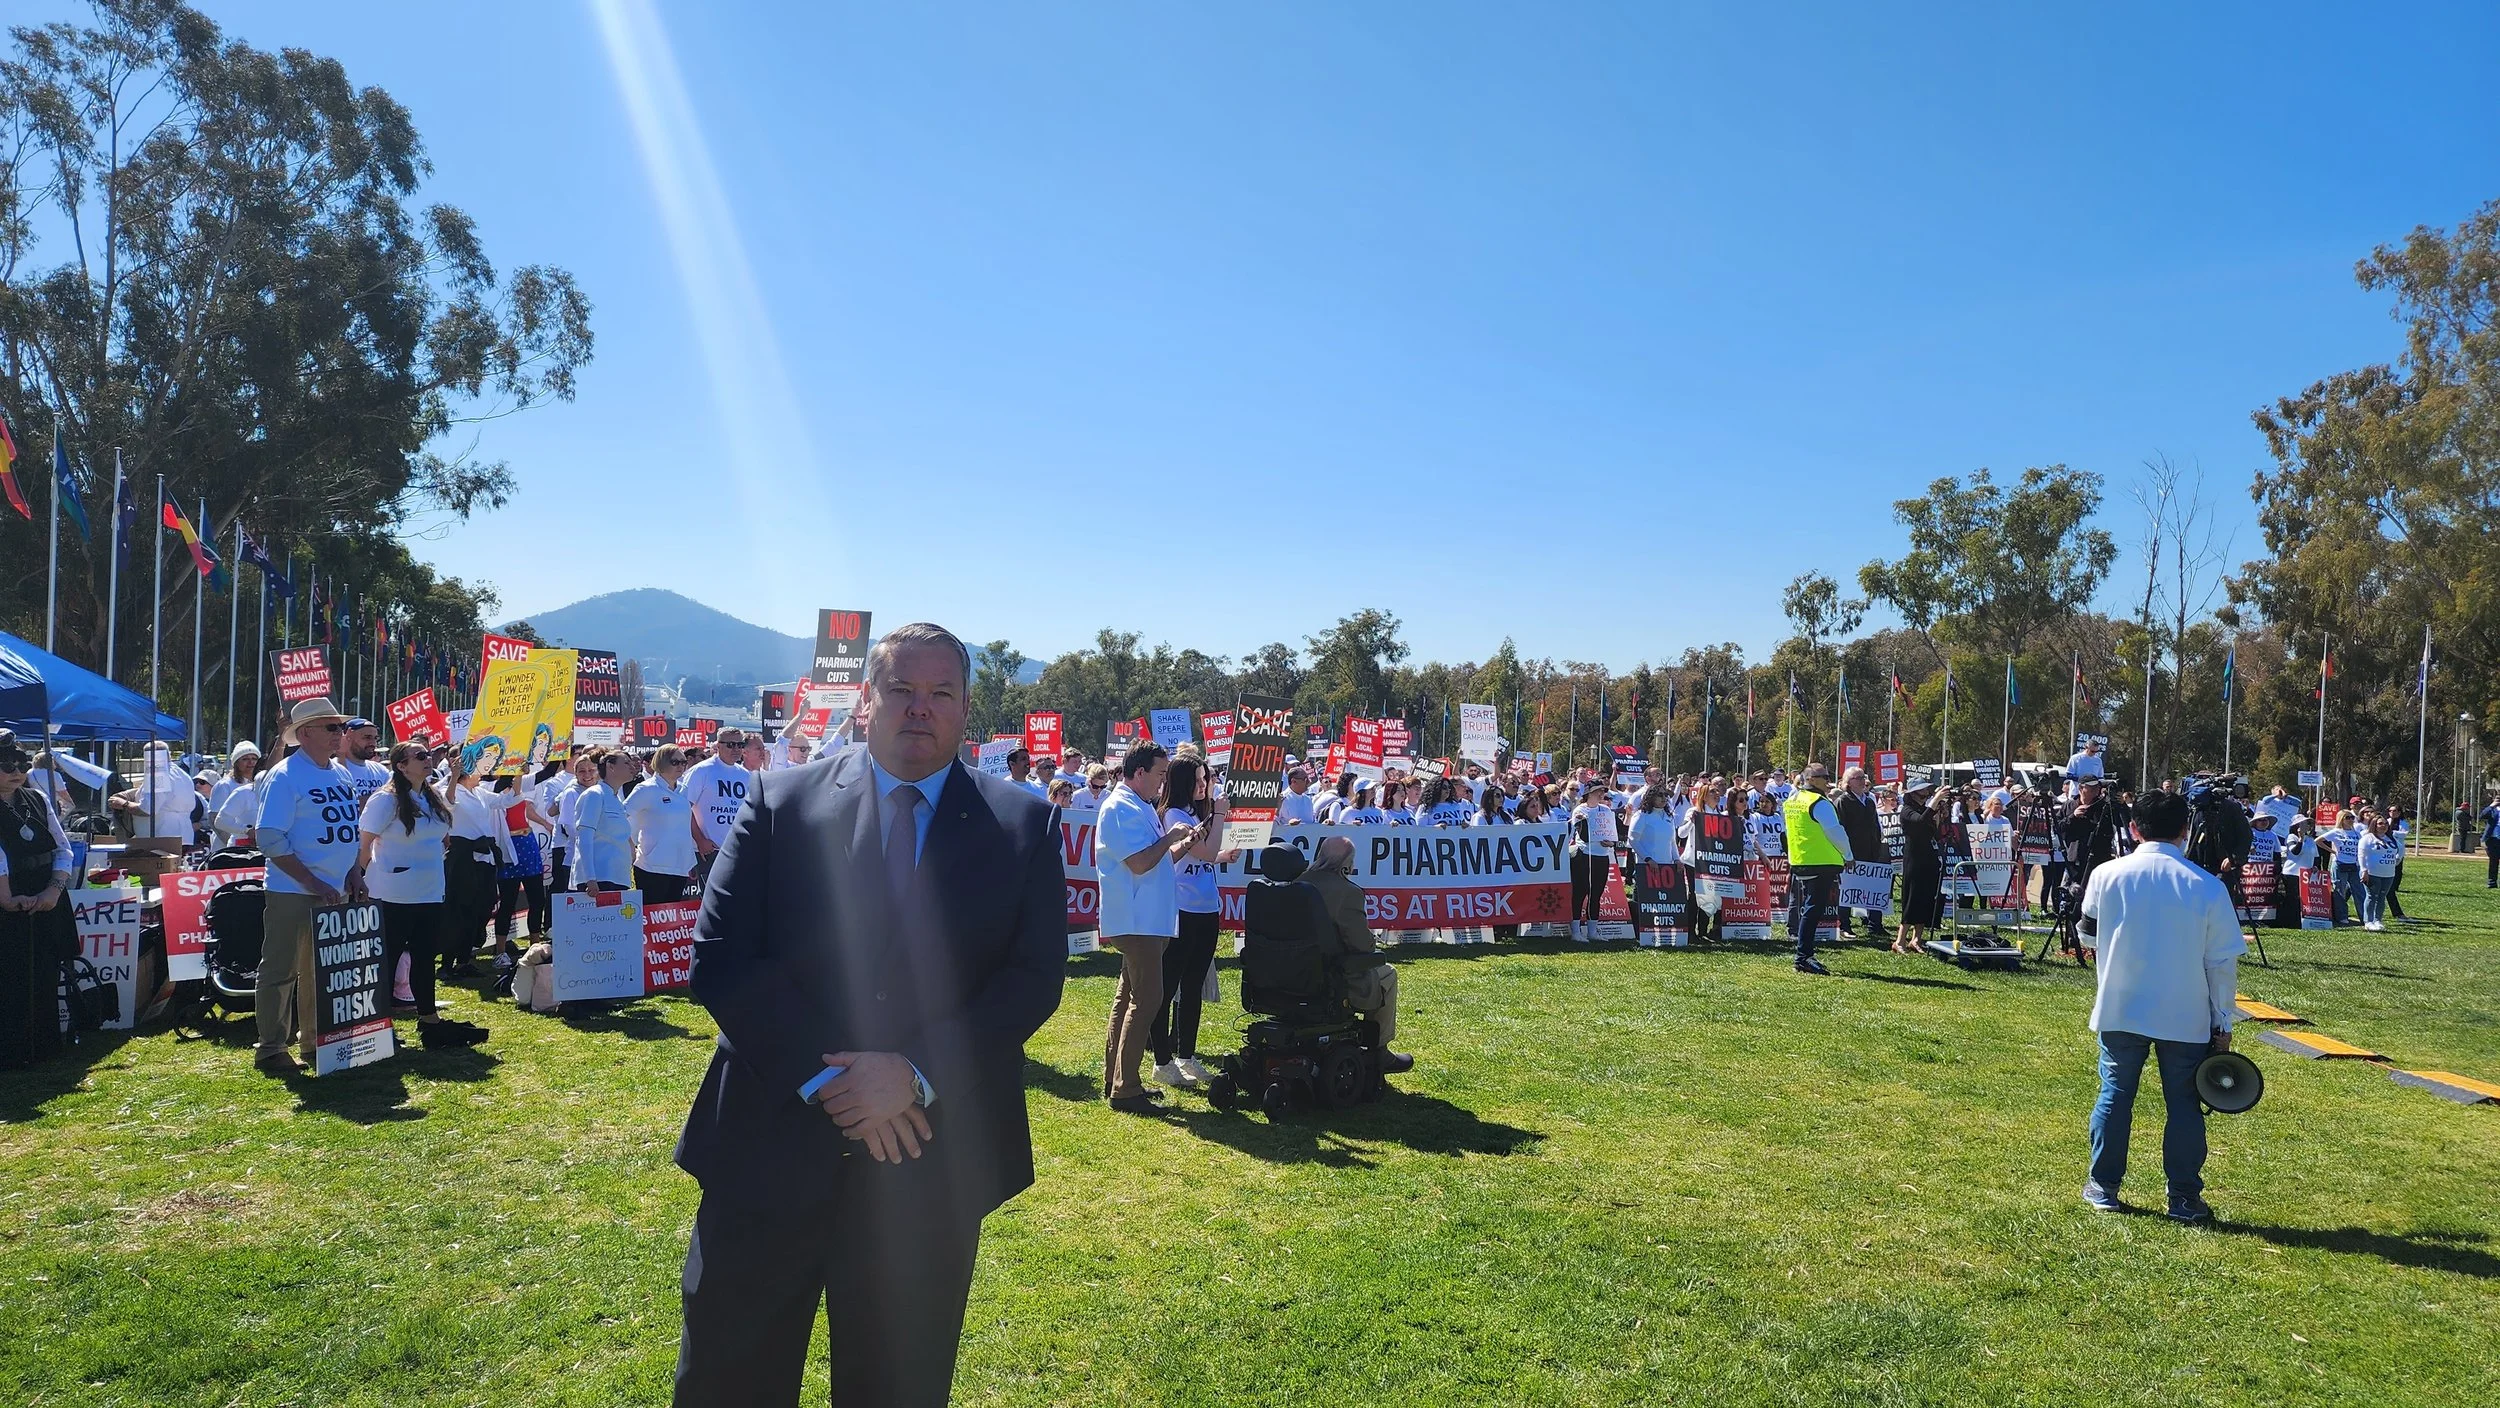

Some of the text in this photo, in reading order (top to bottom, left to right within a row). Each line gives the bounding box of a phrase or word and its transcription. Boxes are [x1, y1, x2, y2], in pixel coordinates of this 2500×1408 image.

[829, 612, 860, 640] NO
[488, 641, 528, 661] SAVE
[838, 643, 847, 654] to
[280, 650, 322, 672] SAVE
[577, 656, 618, 675] SCARE
[816, 656, 864, 668] PHARMACY
[278, 668, 330, 686] COMMUNITY
[505, 672, 536, 684] WONDER,
[826, 671, 850, 683] CUTS
[284, 682, 331, 700] PHARMACY
[499, 683, 533, 696] HOW CAN
[576, 678, 619, 696] TRUTH
[499, 694, 531, 706] WE STAY
[576, 700, 620, 713] CAMPAIGN
[771, 694, 785, 708] NO
[393, 693, 432, 722] SAVE
[491, 702, 535, 717] OPEN LATE?
[406, 714, 427, 728] YOUR
[804, 713, 819, 721] CAL
[1204, 715, 1232, 727] PAUSE
[1463, 709, 1495, 720] SCARE
[696, 720, 716, 734] NO
[764, 719, 789, 727] PHARMAC
[1030, 717, 1056, 731] SAVE
[1239, 706, 1293, 737] SCARE
[1378, 719, 1404, 730] SAVE
[1463, 721, 1495, 732] TRUTH
[643, 720, 667, 737] NO
[1114, 722, 1133, 736] NO
[1158, 725, 1186, 733] SPEARE
[1214, 727, 1226, 735] and
[1310, 726, 1323, 734] NO
[1351, 721, 1378, 736] SAVE
[676, 732, 702, 744] AVE
[1358, 735, 1372, 743] YOUR
[1463, 733, 1496, 741] CAMPAIGN
[1333, 746, 1345, 757] SA
[1356, 744, 1373, 752] LOCAL
[1612, 745, 1638, 754] NO
[983, 753, 1007, 766] JOBS
[1233, 743, 1284, 772] TRUTH
[1350, 751, 1379, 762] PHARMACY
[1416, 758, 1444, 773] 20,000
[1512, 759, 1534, 771] SAVE
[1906, 764, 1932, 773] 20,000
[1414, 769, 1437, 780] WOME
[308, 786, 355, 804] SAV
[718, 780, 746, 799] NO
[1226, 780, 1279, 798] CAMPAIGN
[1775, 791, 1789, 799] NO
[322, 806, 359, 823] OU
[716, 816, 735, 825] CU
[1704, 815, 1733, 839] NO
[1762, 823, 1782, 834] NO
[1883, 828, 1903, 836] OMEN
[1968, 831, 2008, 843] SCARE
[1715, 841, 1723, 850] to
[1890, 846, 1903, 856] SK
[1370, 834, 1566, 875] PHARMACY
[1697, 851, 1742, 865] PHARMACY
[1708, 865, 1730, 875] CUTS
[1770, 859, 1788, 871] AVE
[2243, 864, 2274, 875] SAVE
[1646, 865, 1675, 889] NO
[1744, 864, 1765, 881] VE
[1746, 884, 1756, 892] UR
[1600, 897, 1615, 905] CAL
[1659, 891, 1666, 900] to
[1406, 892, 1515, 920] AT RISK
[1641, 904, 1685, 913] PHARMACY
[2303, 907, 2330, 915] PHARMACY
[74, 901, 137, 925] ARE
[650, 910, 677, 924] NOW
[1725, 909, 1768, 918] PHARMACY
[317, 904, 380, 942] 20,000
[1654, 916, 1674, 926] CUTS
[566, 933, 628, 946] to PROTECT
[651, 925, 694, 945] negotia
[319, 936, 383, 967] WOMEN'S
[581, 950, 616, 963] OUR
[648, 947, 694, 965] the 8CP
[326, 964, 380, 993] JOBS AT
[652, 968, 689, 986] Mr Bu
[333, 989, 377, 1024] RISK
